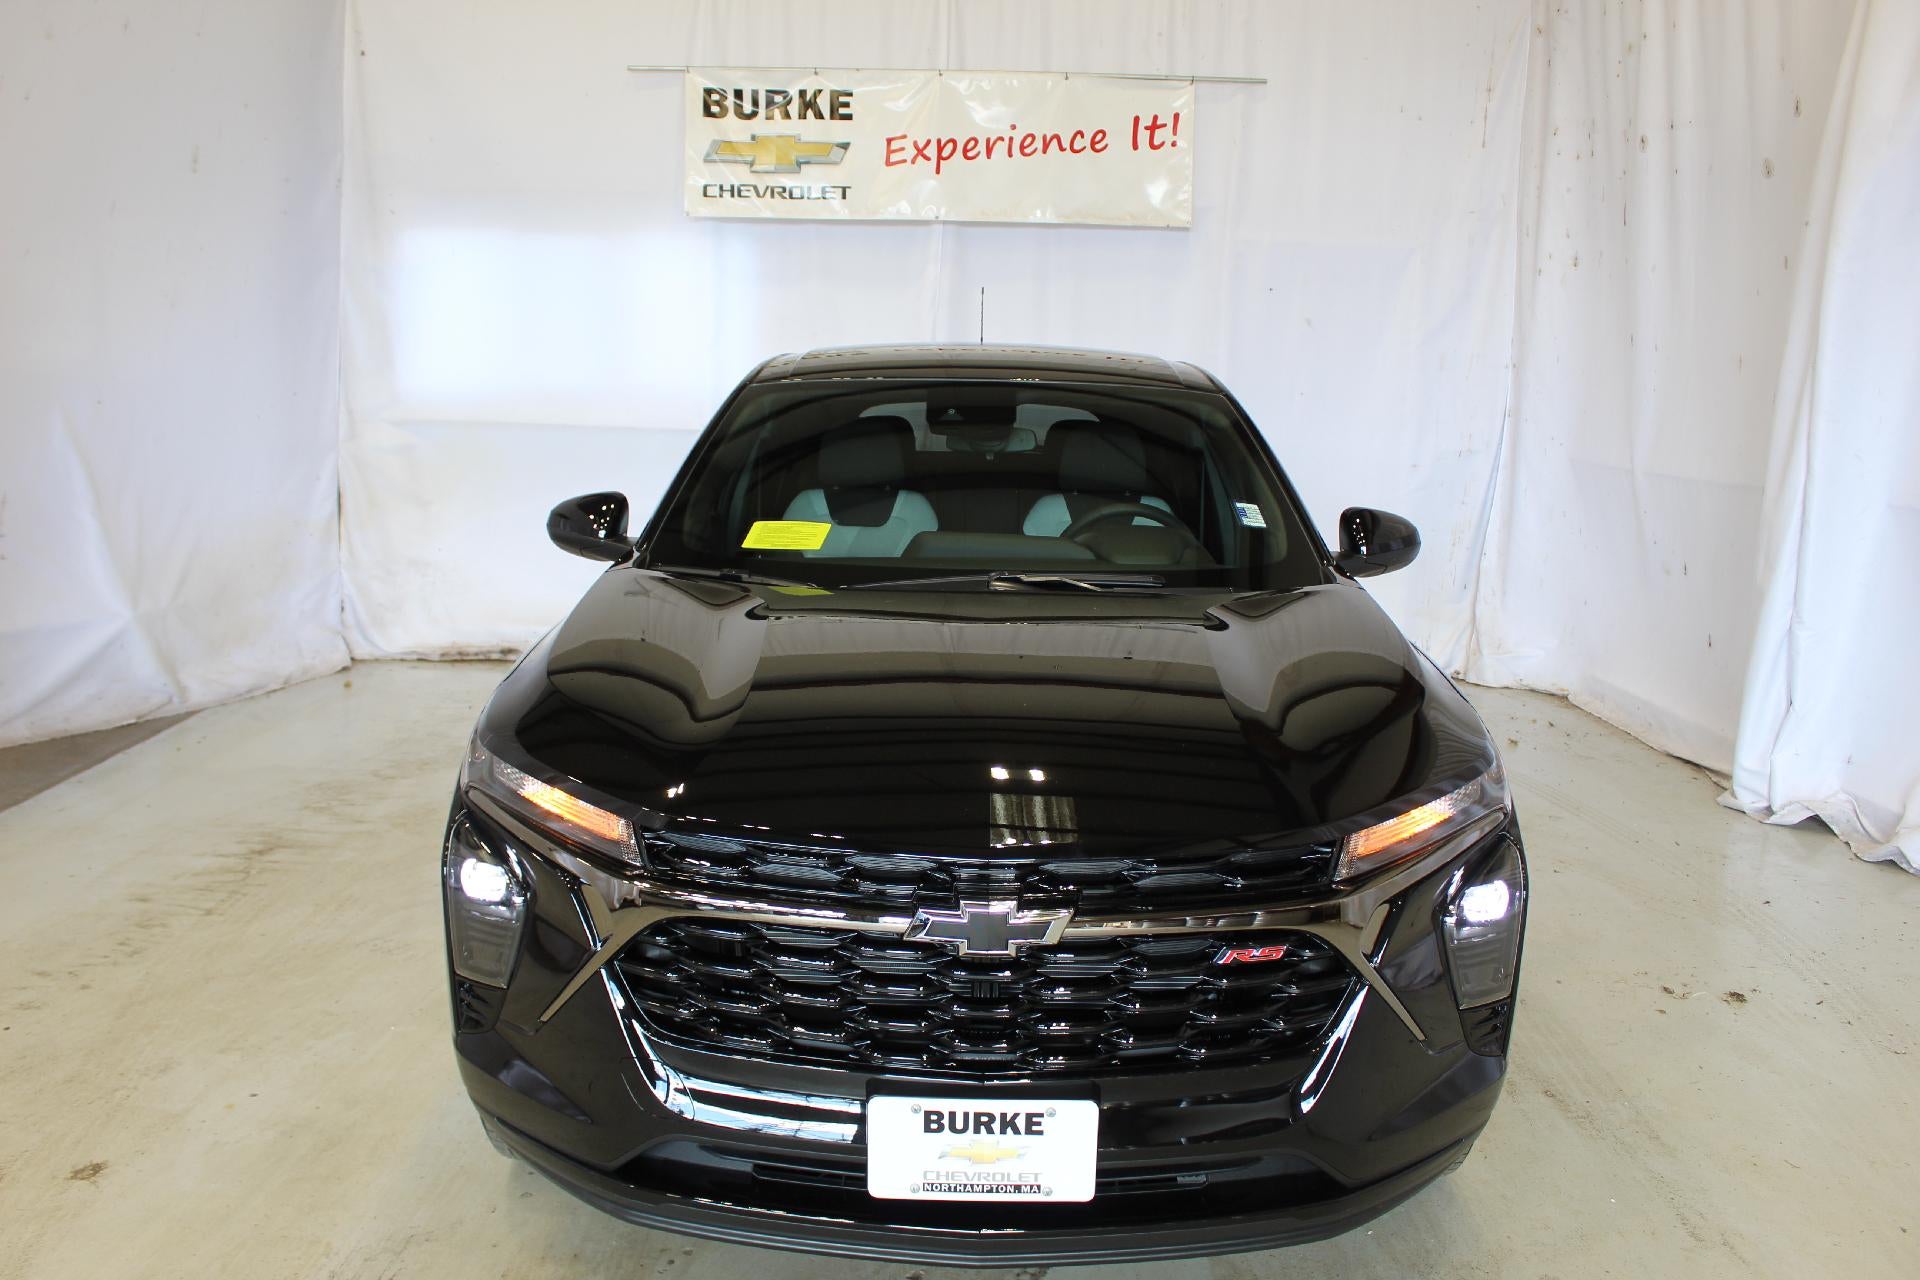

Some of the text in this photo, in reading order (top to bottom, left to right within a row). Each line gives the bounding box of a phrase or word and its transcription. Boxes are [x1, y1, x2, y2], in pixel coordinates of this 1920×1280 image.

[702, 87, 854, 121] BURKE
[885, 111, 1181, 175] Experience It!
[702, 183, 852, 200] CHEVROLET
[1223, 945, 1286, 964] RS
[923, 1110, 1045, 1136] BURKE
[923, 1170, 1042, 1183] CHEVROLET
[1021, 1184, 1040, 1194] MA
